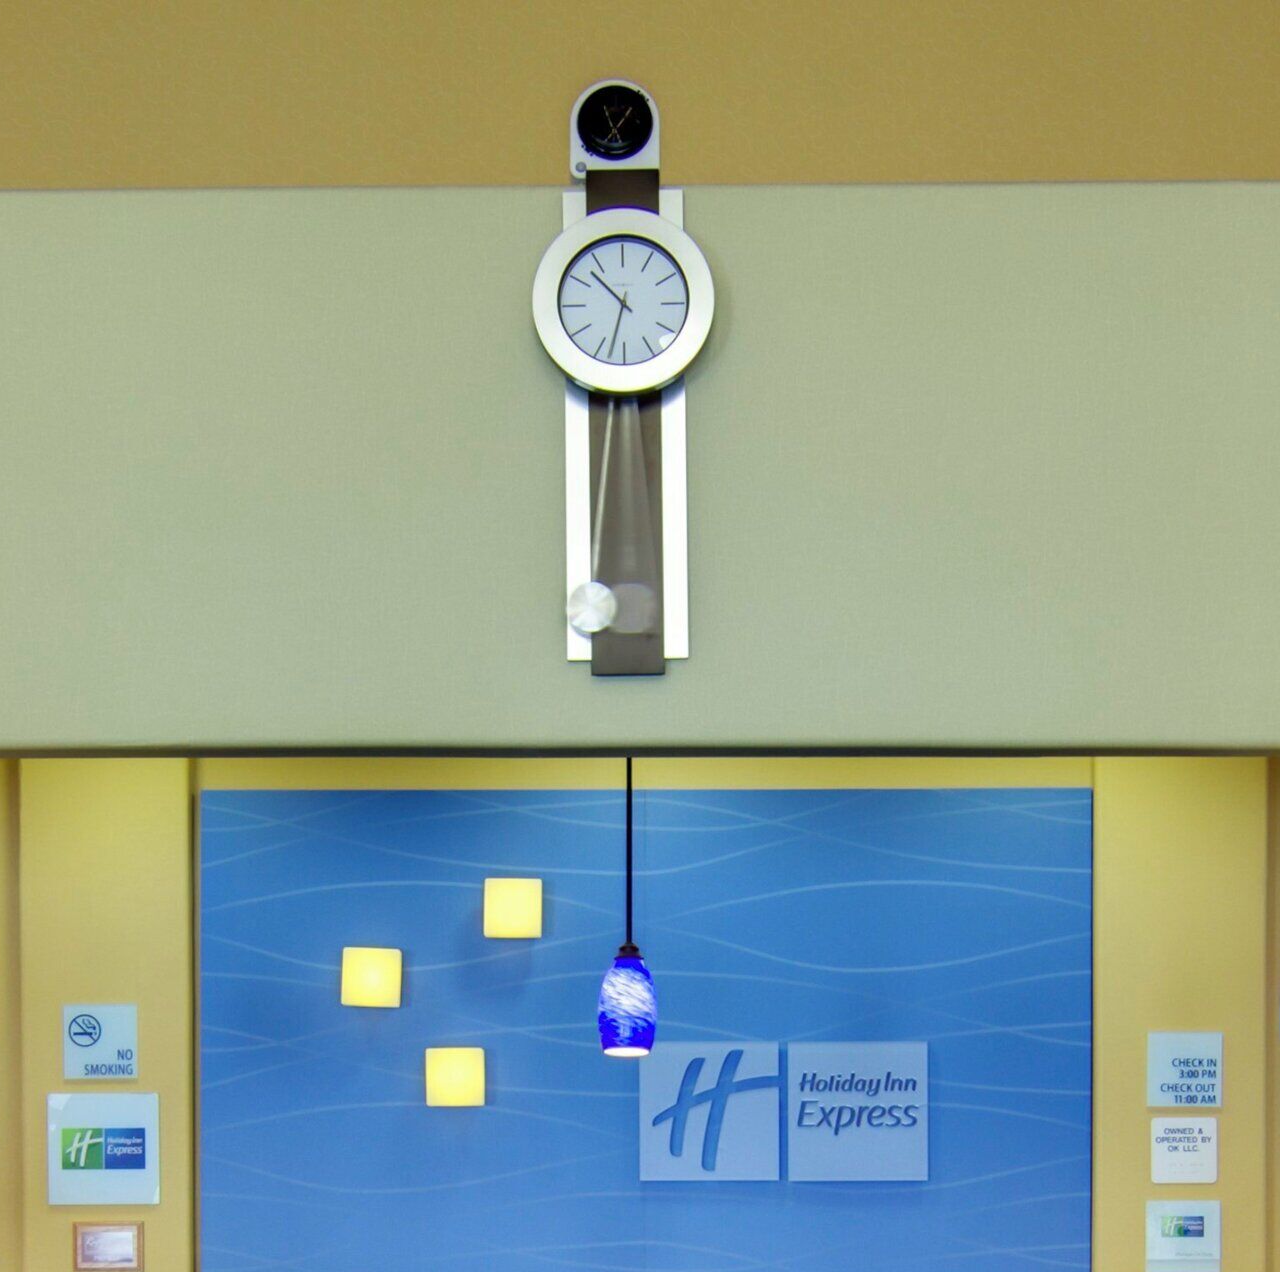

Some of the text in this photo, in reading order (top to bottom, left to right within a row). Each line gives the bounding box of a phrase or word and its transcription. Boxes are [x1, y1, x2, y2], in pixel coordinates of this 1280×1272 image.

[116, 1048, 133, 1061] NO
[1171, 1057, 1217, 1068] CHECK IN
[84, 1063, 134, 1076] SMOKING
[1178, 1069, 1217, 1079] 3:00 PM
[799, 1072, 917, 1097] Holiday Inn
[1160, 1082, 1216, 1093] CHECK OUT
[1174, 1094, 1217, 1104] 11:00 AM
[797, 1100, 919, 1136] Express
[1163, 1127, 1195, 1135] OWNED
[1155, 1136, 1212, 1144] OPERATED BY
[106, 1144, 143, 1156] Express
